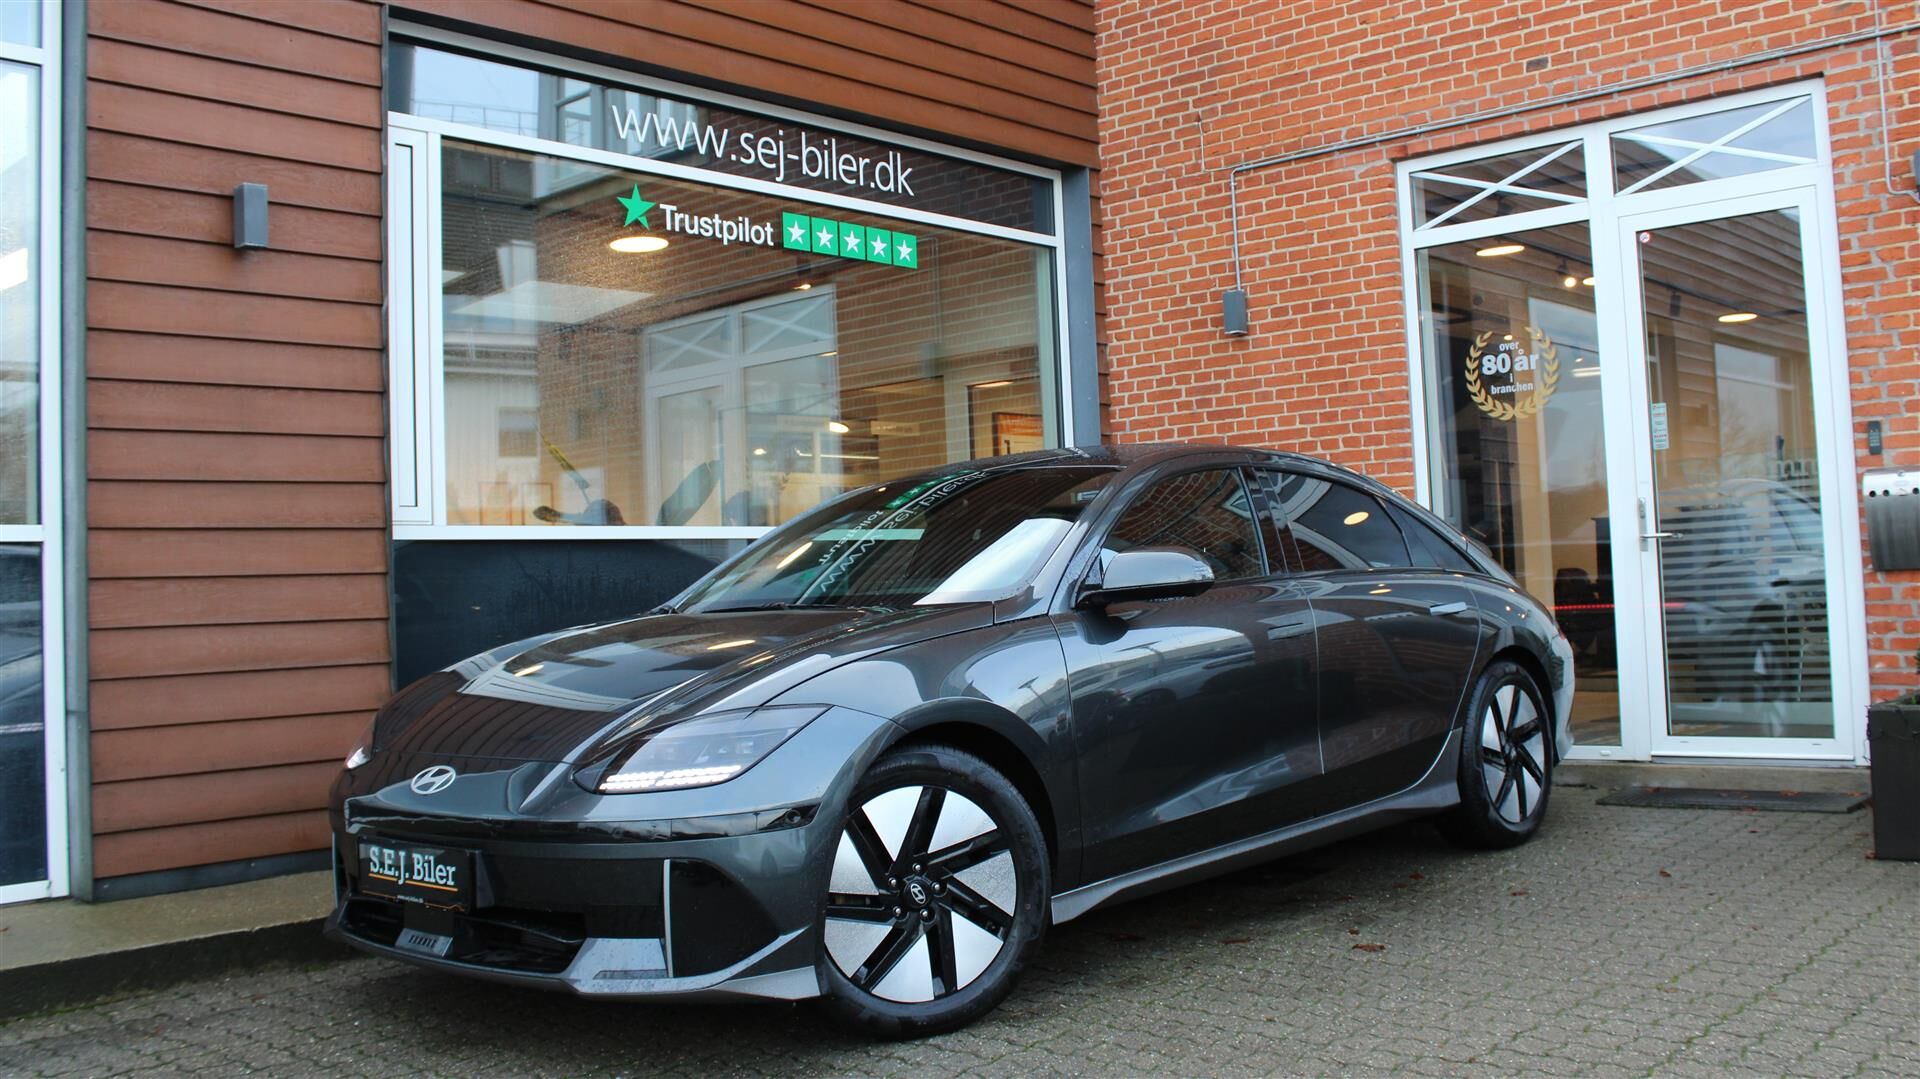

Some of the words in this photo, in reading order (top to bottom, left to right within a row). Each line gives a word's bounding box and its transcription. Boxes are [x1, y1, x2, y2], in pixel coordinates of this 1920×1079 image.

[611, 104, 914, 197] www.sej-biler.dk
[659, 204, 774, 247] Trustpilot
[1481, 353, 1511, 375] 80
[1514, 349, 1539, 371] år
[1498, 341, 1518, 352] over
[1491, 382, 1533, 394] branchen
[369, 846, 409, 885] S.E.J.
[412, 853, 456, 886] Biler
